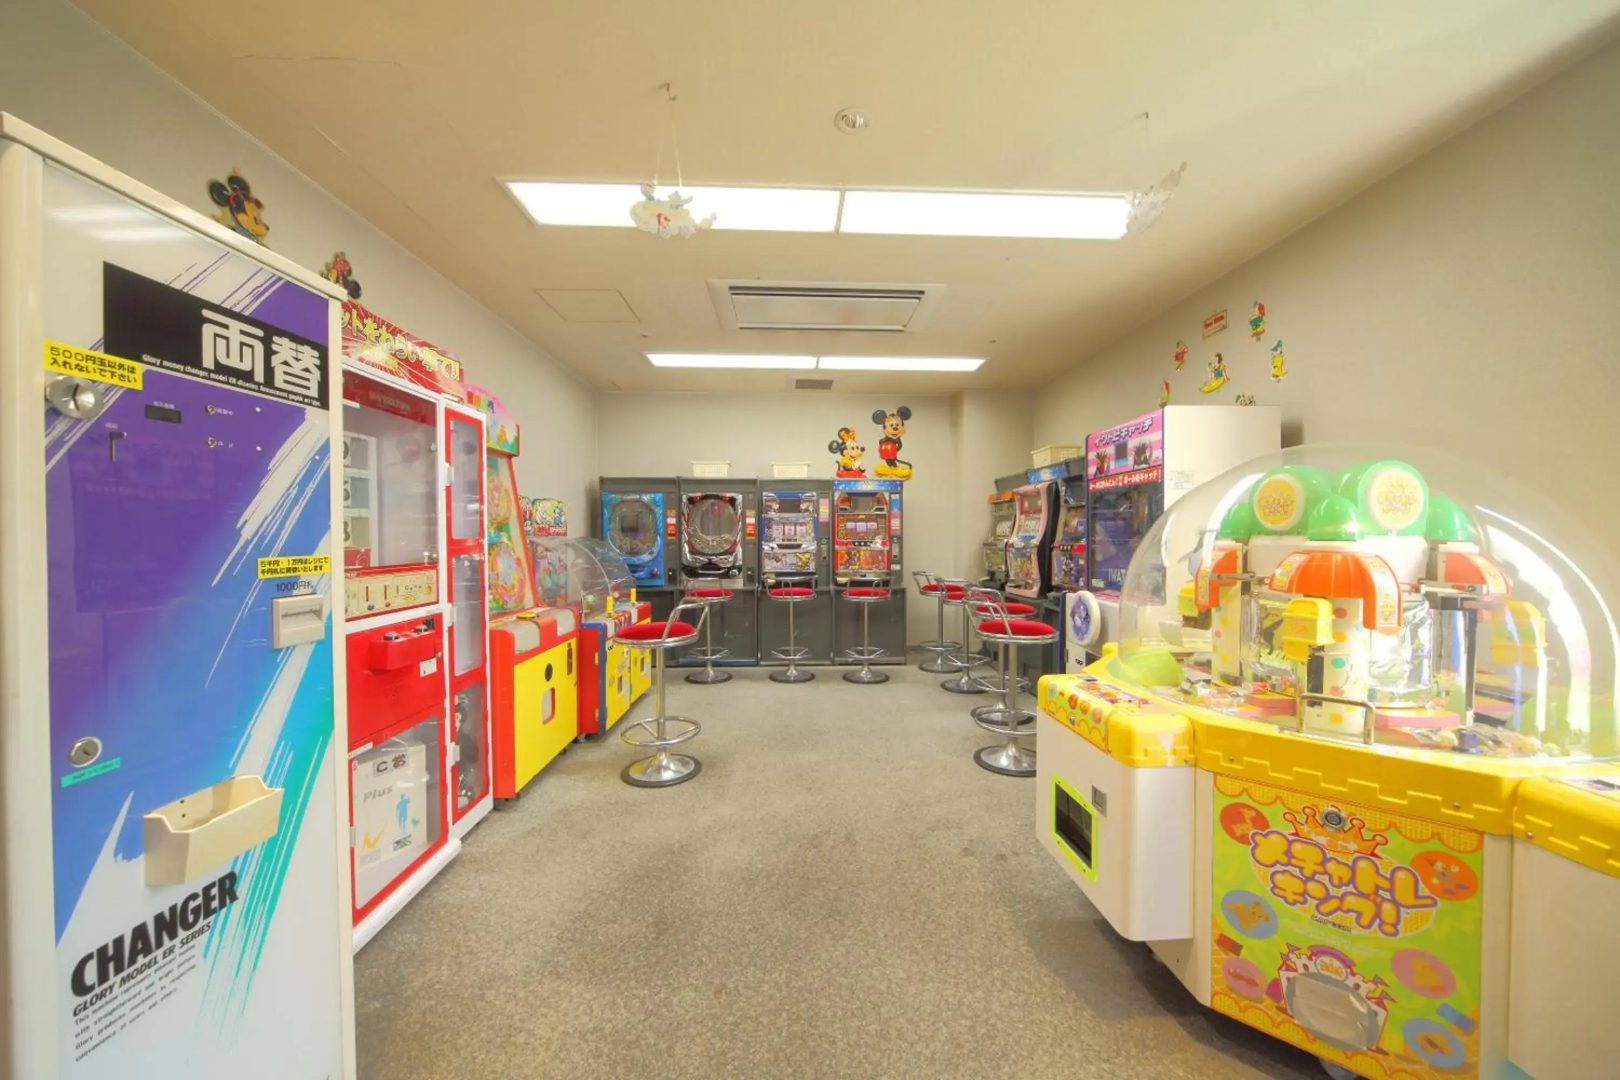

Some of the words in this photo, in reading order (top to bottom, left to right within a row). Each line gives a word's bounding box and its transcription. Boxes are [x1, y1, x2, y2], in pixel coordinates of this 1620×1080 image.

[50, 346, 136, 374] 500円玉以外は
[142, 354, 160, 365] Glory
[162, 360, 184, 371] money
[202, 308, 321, 399] 両替
[50, 357, 137, 383] 入れないで下さい
[276, 580, 314, 592] 1000円札
[71, 871, 239, 997] CHANGER
[73, 982, 116, 1017] GLORY
[119, 955, 159, 989] MODEL
[162, 944, 176, 960] ER
[179, 921, 211, 949] SERIES
[75, 1035, 94, 1050] Glory
